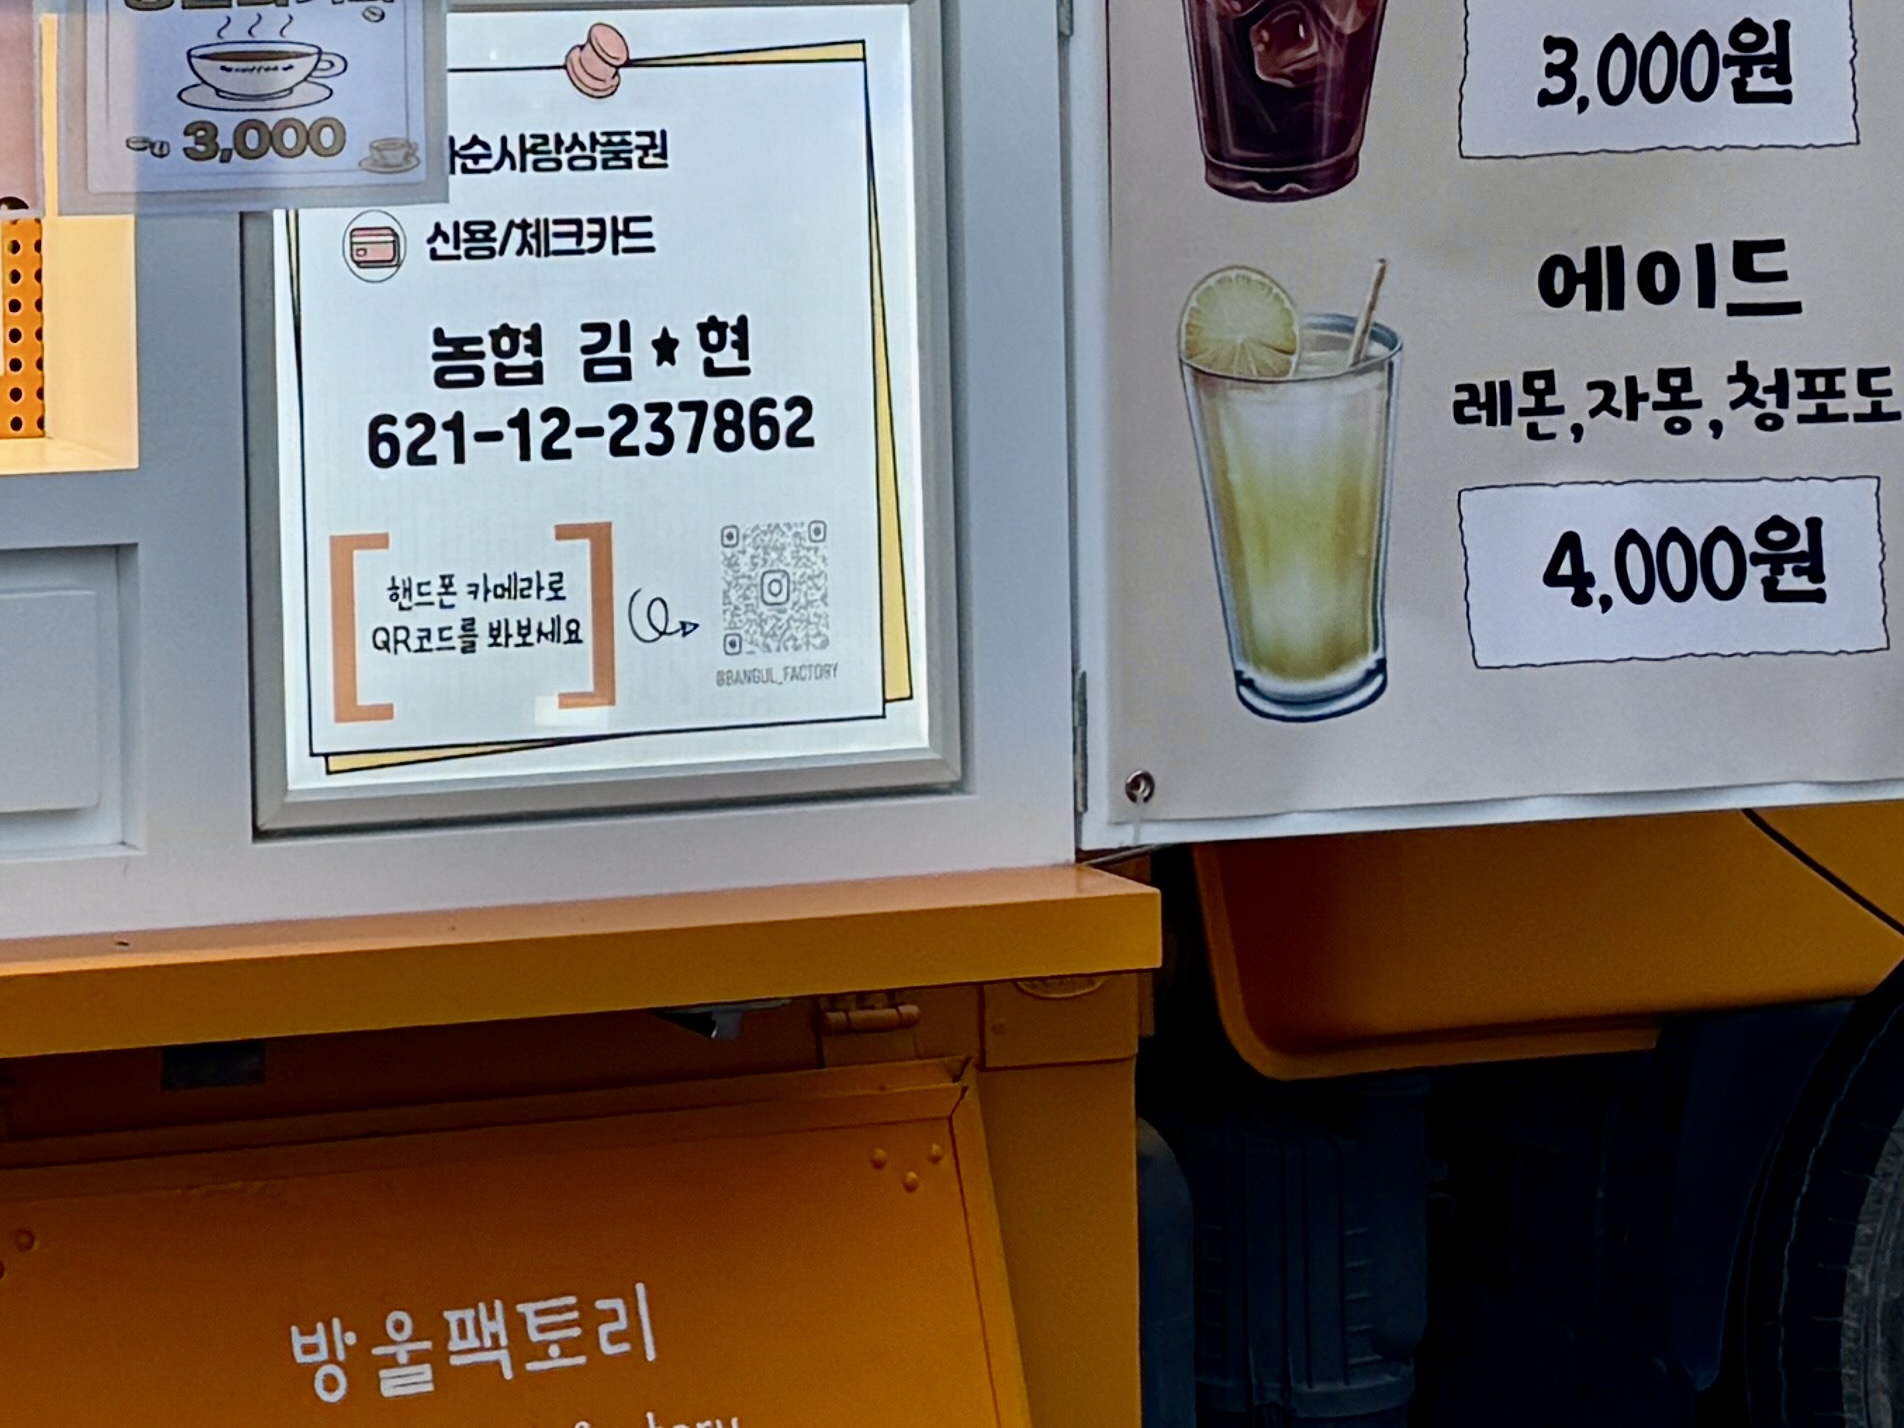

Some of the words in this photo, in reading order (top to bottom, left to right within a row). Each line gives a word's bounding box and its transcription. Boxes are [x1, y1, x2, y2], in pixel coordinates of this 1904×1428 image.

[1536, 16, 1794, 115] 3,000원
[182, 116, 348, 164] 3,000
[448, 128, 670, 176] 순사랑상품권
[425, 214, 657, 261] 신용/체크카드
[1537, 237, 1803, 318] 에이드
[431, 324, 545, 390] 농협
[367, 396, 816, 469] 621-12-237862
[1451, 360, 1903, 443] 레몬,자몽,청포도
[387, 576, 458, 610] 핸드폰
[465, 570, 567, 603] 카메라로
[1541, 514, 1828, 613] 4,000원
[371, 616, 477, 655] QR코드를
[487, 613, 585, 649] 봐보세요
[290, 1282, 656, 1403] 방울팩토리
